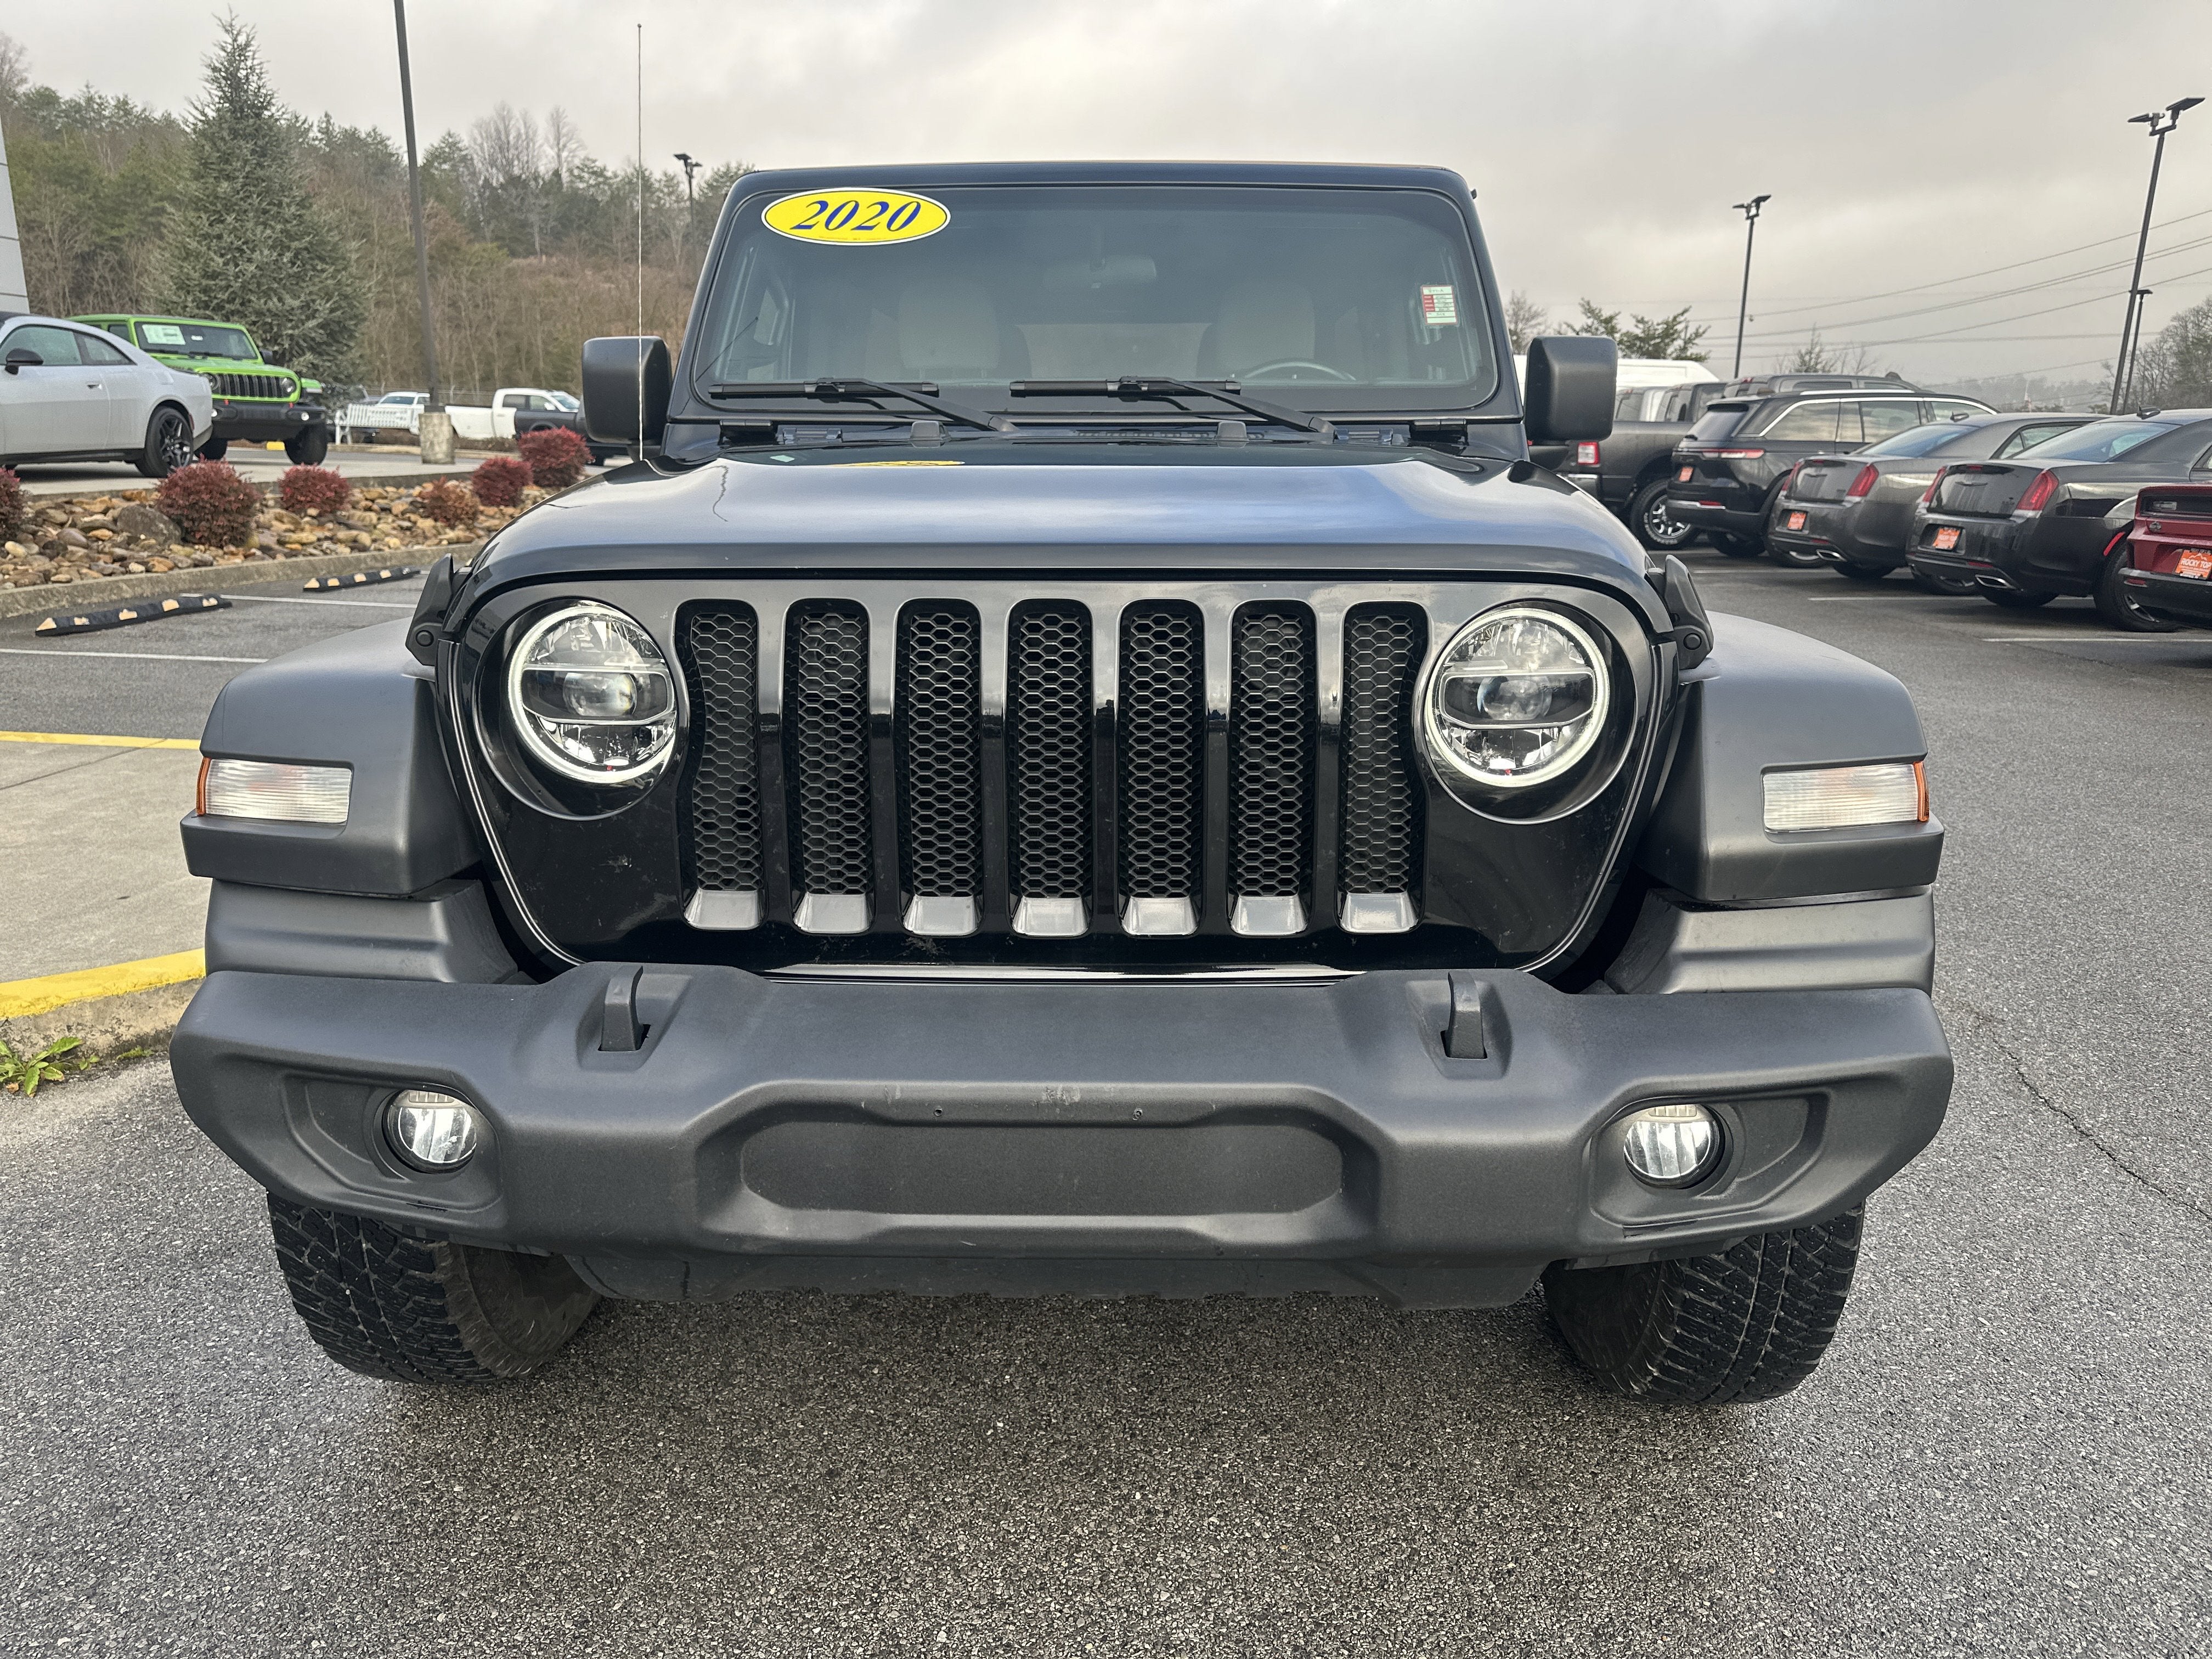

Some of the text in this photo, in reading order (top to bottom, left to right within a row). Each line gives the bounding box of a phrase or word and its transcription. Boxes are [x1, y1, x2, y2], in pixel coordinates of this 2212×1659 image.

[789, 200, 921, 232] 2020
[2180, 558, 2200, 567] ROCKY
[2199, 561, 2211, 569] TOP
